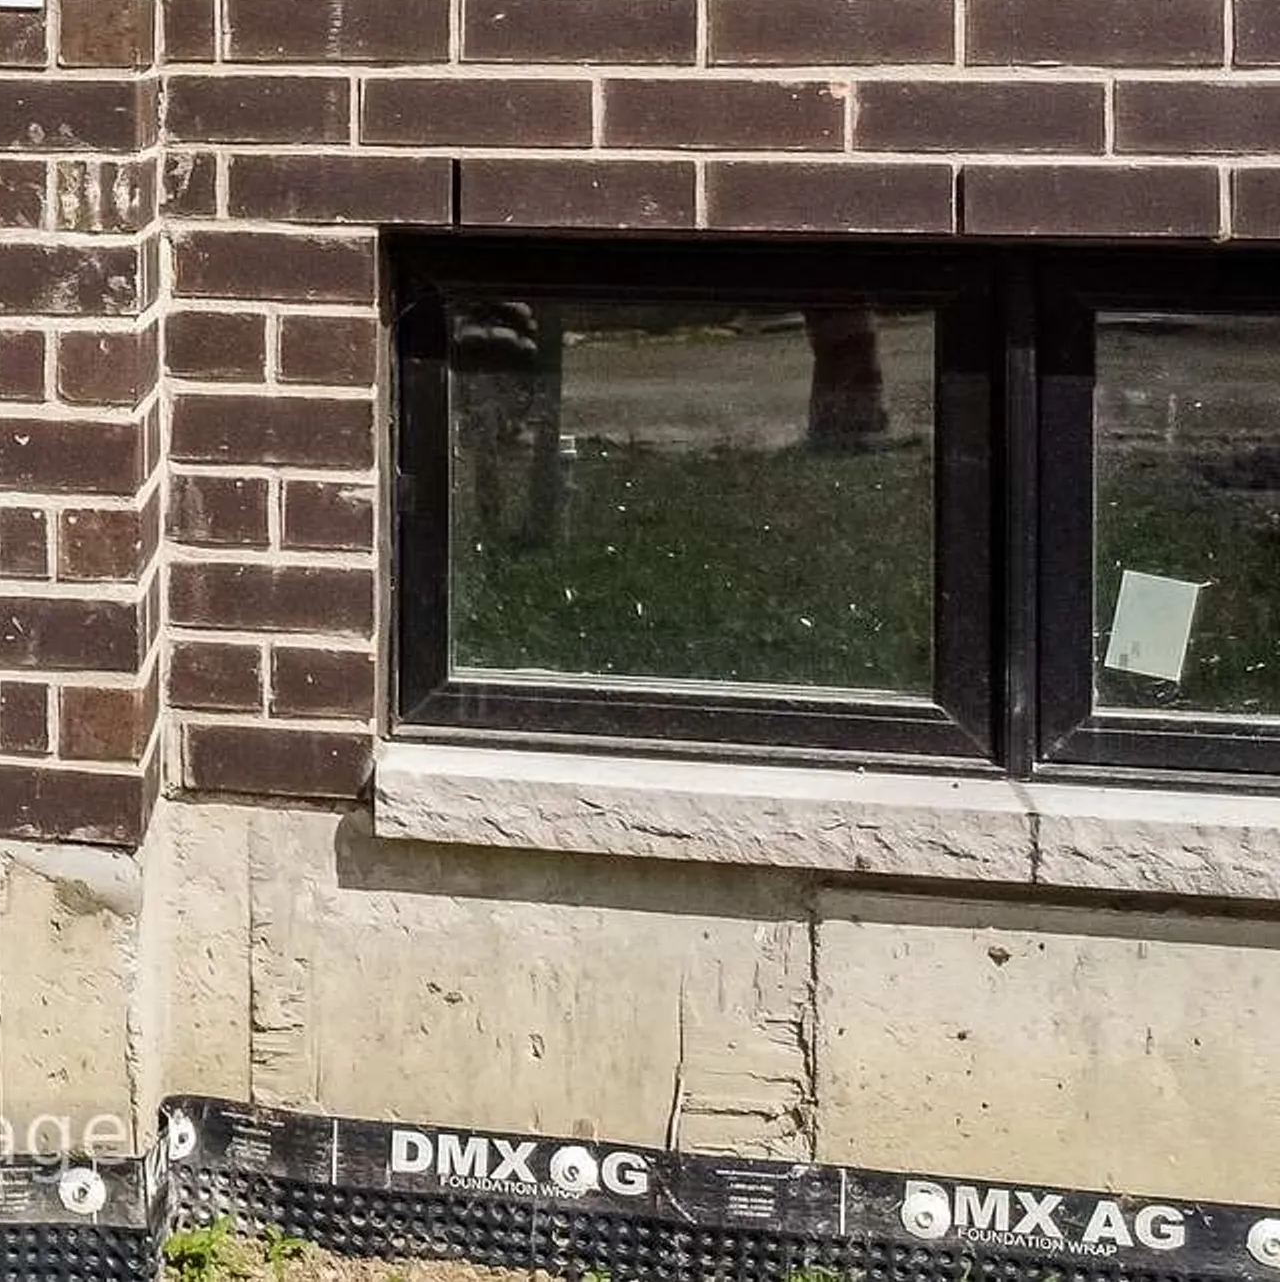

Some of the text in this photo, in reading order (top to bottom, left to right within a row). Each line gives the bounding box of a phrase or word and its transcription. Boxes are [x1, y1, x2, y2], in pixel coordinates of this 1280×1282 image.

[392, 1129, 538, 1184] DMX
[440, 1176, 538, 1197] FOUNDATION
[957, 1227, 1118, 1258] FOUNDATION WRAP
[1082, 1199, 1186, 1251] AG
